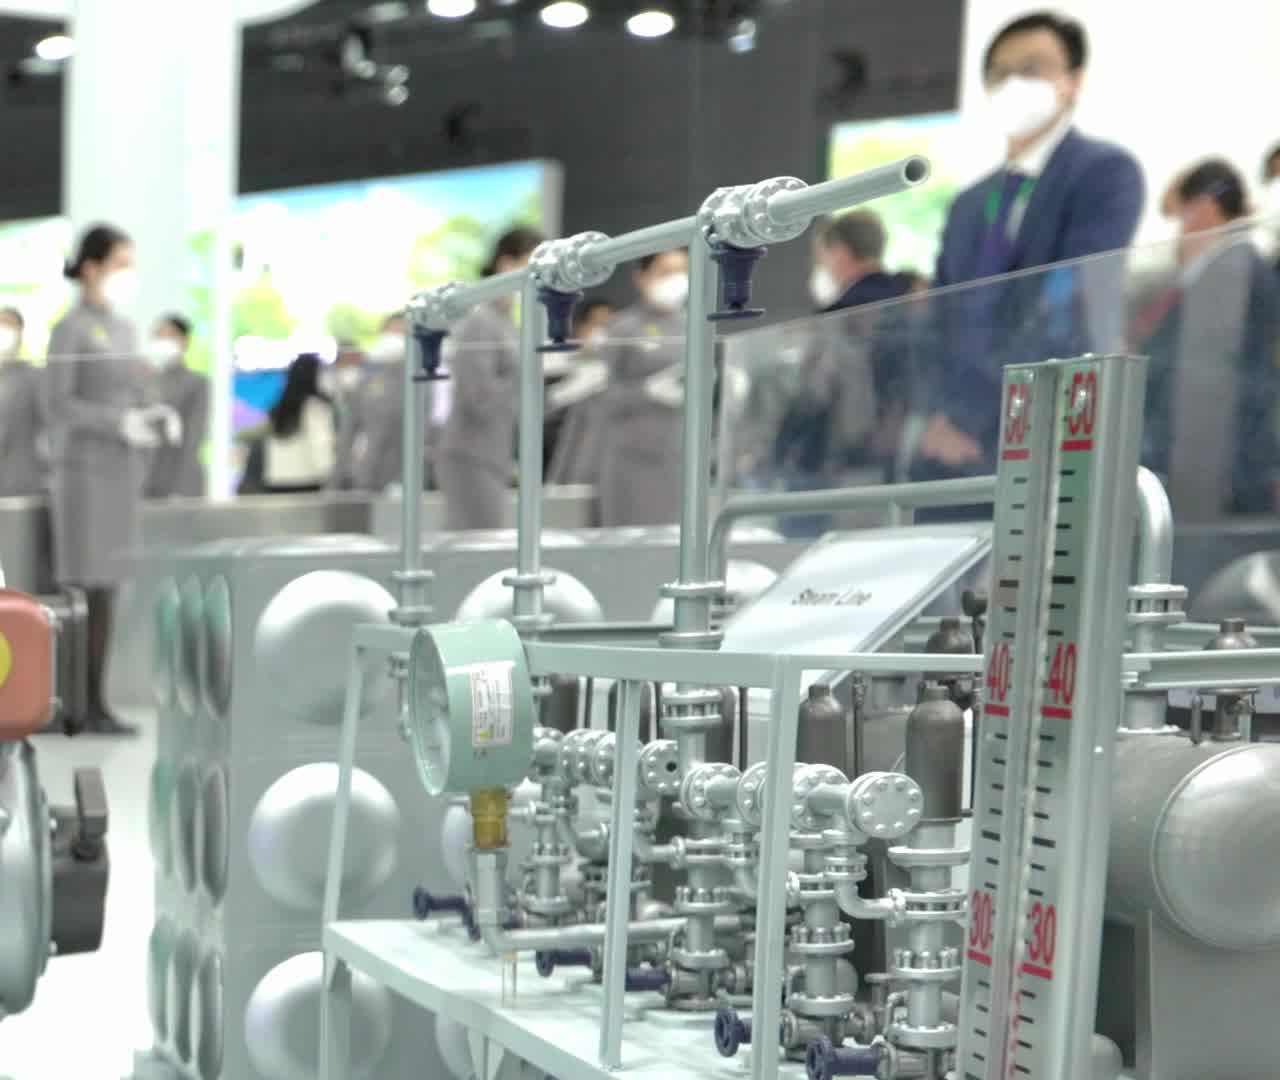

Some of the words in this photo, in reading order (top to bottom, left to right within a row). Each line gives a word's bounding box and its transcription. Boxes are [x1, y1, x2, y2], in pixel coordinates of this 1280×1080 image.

[1005, 384, 1030, 444] 50
[1068, 371, 1097, 436] 50
[986, 641, 1010, 702] 40
[1048, 641, 1078, 706] 40
[970, 890, 993, 949] 30
[1028, 902, 1057, 966] 30
